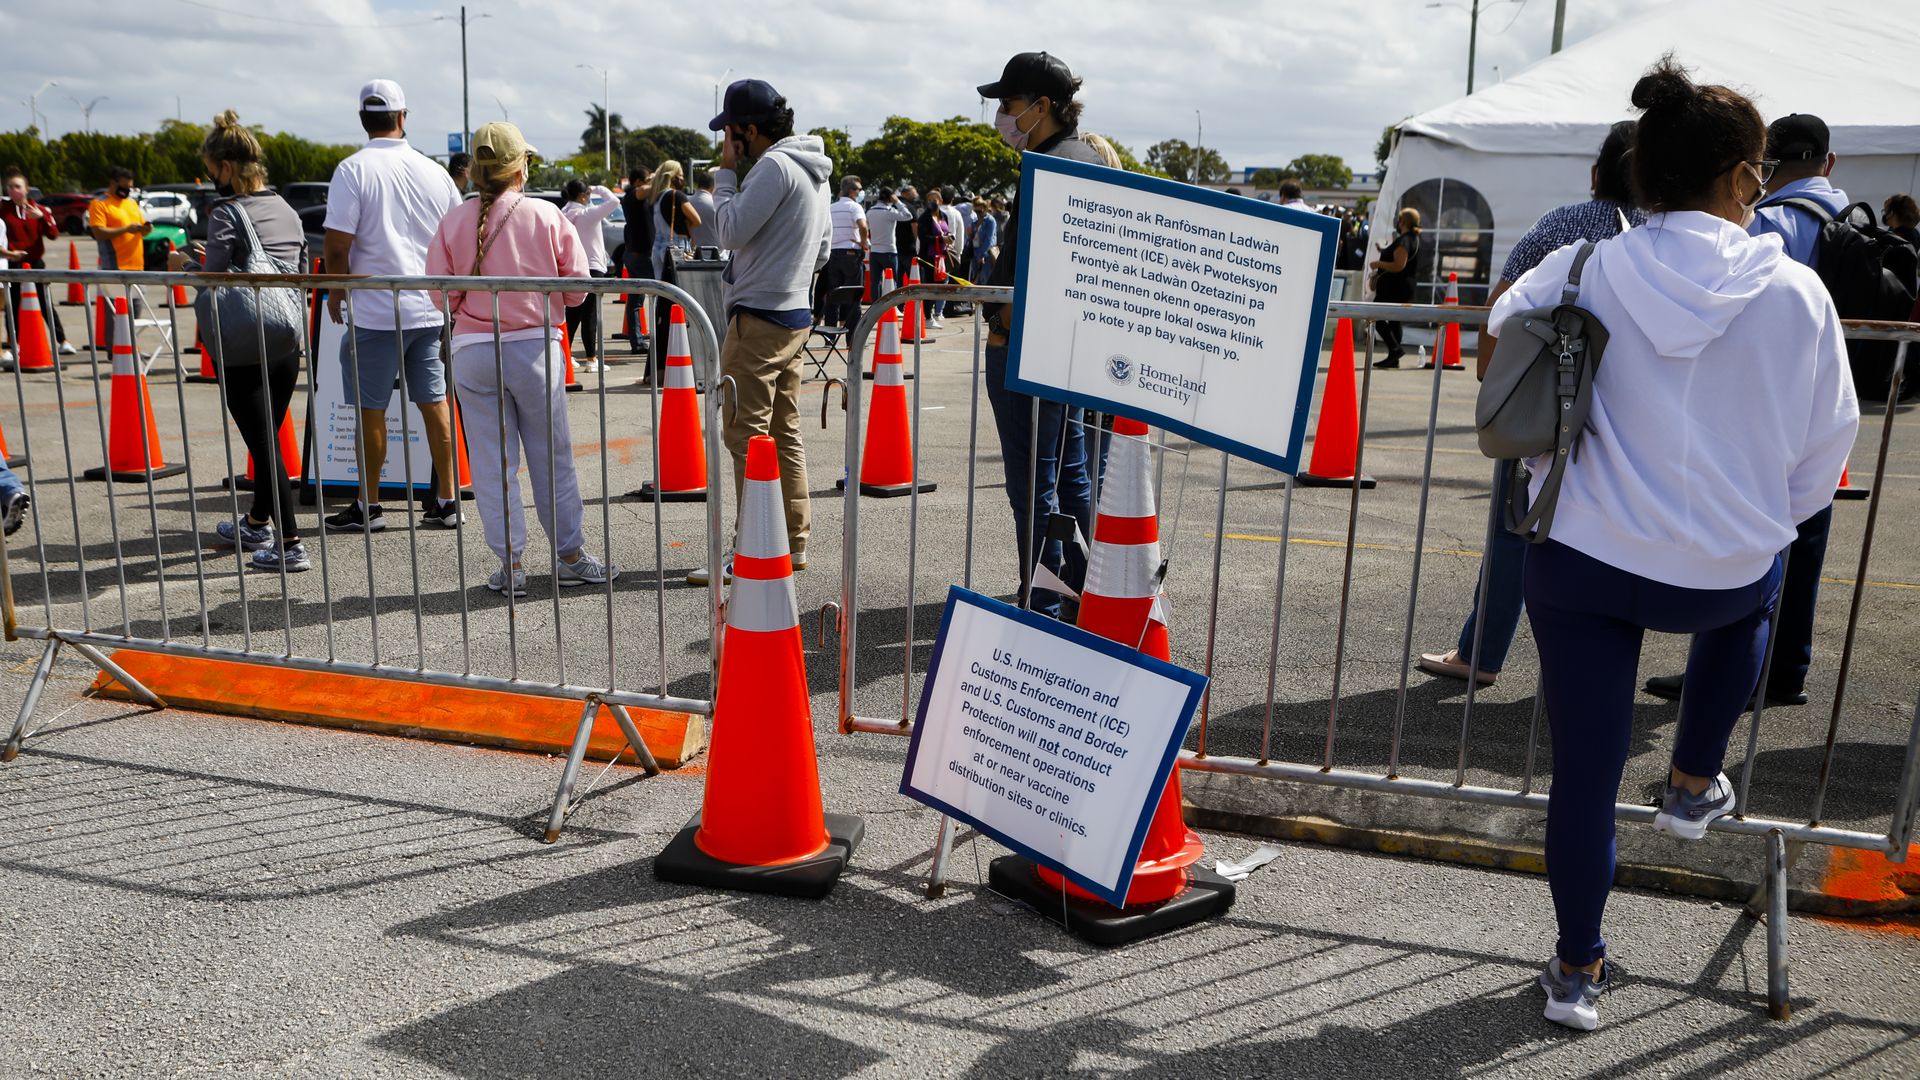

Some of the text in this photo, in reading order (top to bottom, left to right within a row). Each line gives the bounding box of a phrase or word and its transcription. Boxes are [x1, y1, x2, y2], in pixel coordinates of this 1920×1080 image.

[1063, 213, 1281, 275] Ozetazini (Immigration and Customs
[1068, 195, 1279, 254] Imigrasyon ak Ranfòsman Ladwàn
[1063, 231, 1277, 294] Enforcement (ICE) avèk Pwoteksyon
[1071, 252, 1264, 310] Fwontyè ak Ladwàn Ozetazini pa
[1065, 289, 1263, 349] nan oswa toupre lokal oswa klinik
[1076, 273, 1255, 327] pral mennen okenn operasyon
[1083, 311, 1239, 361] yo kote y ap bay vaksen yo.
[1138, 377, 1190, 405] Security
[1139, 363, 1206, 394] Homeland
[971, 662, 1130, 738] Customs Enforcement (ICE)
[993, 648, 1119, 708] U.S. Immigration and
[961, 682, 1128, 758] and U.S. Customs and Border
[962, 701, 1112, 776] Protection will not conduct
[964, 726, 1095, 792] enforcement operations
[973, 752, 1069, 805] at or near vaccine
[949, 760, 1088, 838] distribution sites or clinics.
